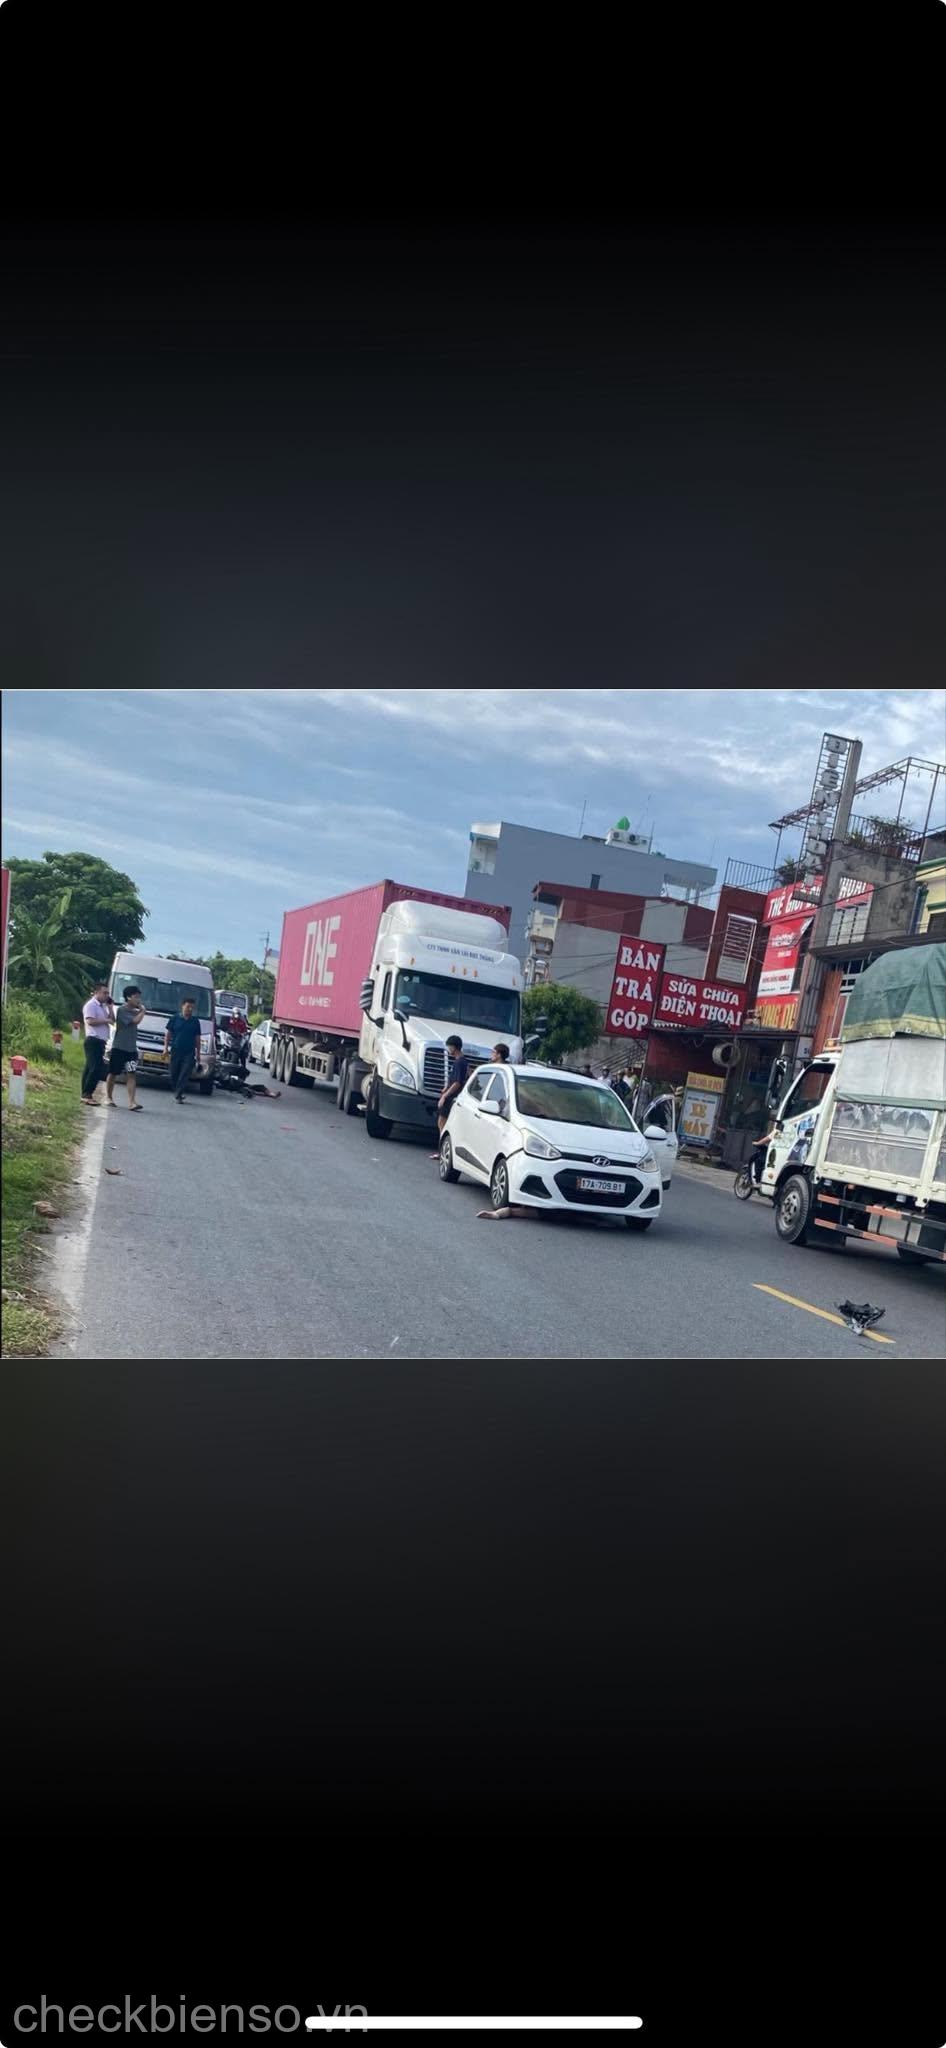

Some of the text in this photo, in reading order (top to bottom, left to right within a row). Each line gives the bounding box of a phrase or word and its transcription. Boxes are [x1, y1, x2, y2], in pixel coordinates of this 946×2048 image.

[300, 915, 341, 986] ONE
[620, 944, 660, 972] BÁN
[616, 976, 653, 1002] TRẢ
[668, 978, 739, 1006] SỬA CHỮA
[611, 1006, 648, 1031] GÓP
[661, 996, 742, 1028] ĐIỆN THOẠI
